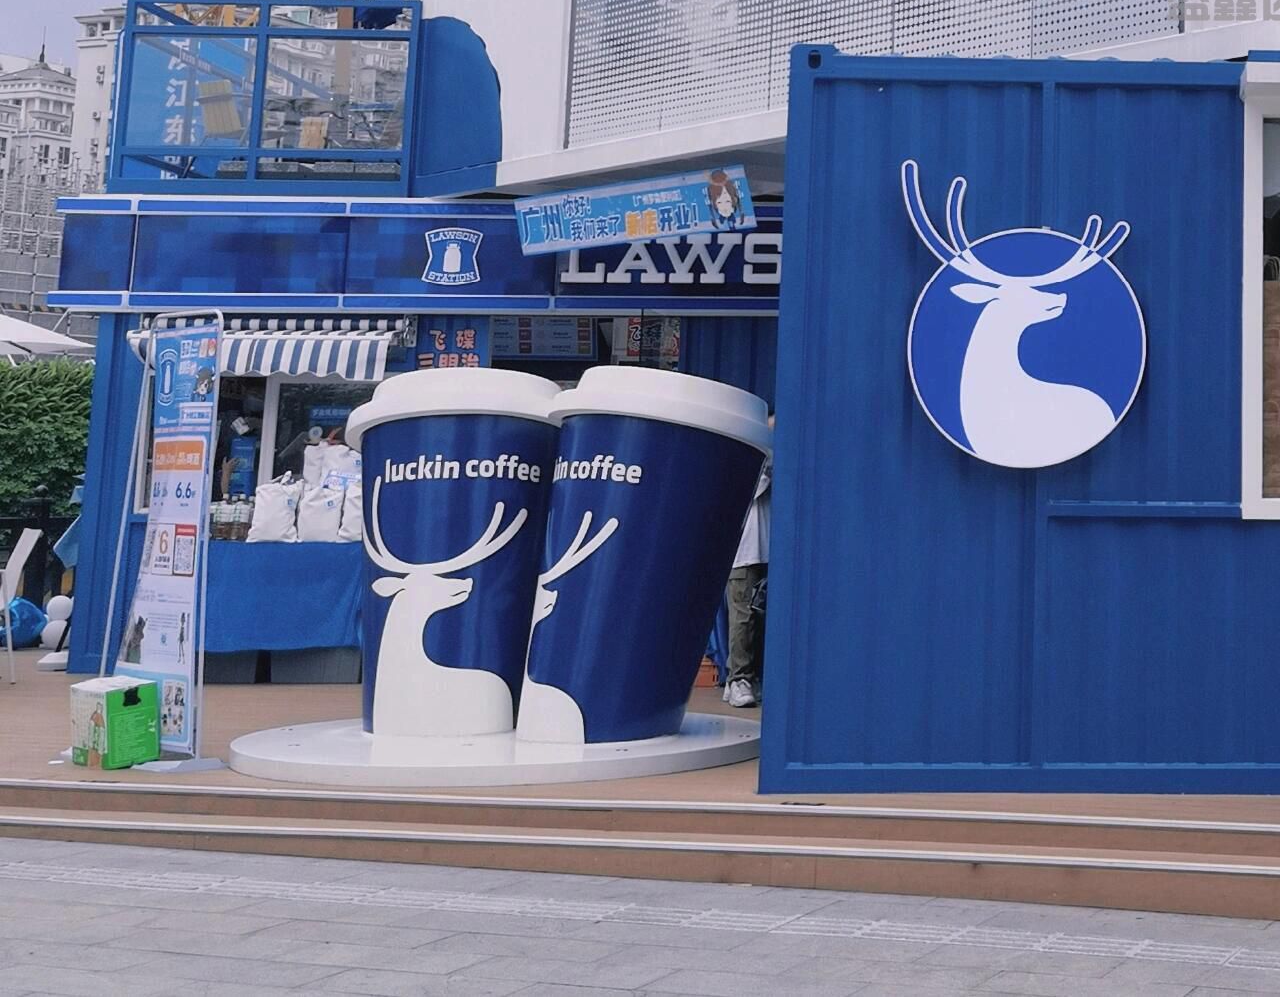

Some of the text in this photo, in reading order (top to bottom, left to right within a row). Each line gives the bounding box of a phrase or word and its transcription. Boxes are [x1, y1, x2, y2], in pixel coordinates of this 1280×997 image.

[430, 232, 477, 244] LAWSON
[521, 204, 564, 246] 广州
[570, 213, 621, 242] 我们来了
[427, 271, 475, 283] STATION
[385, 455, 459, 483] luckin
[465, 454, 540, 483] coffee
[570, 454, 642, 484] coffee
